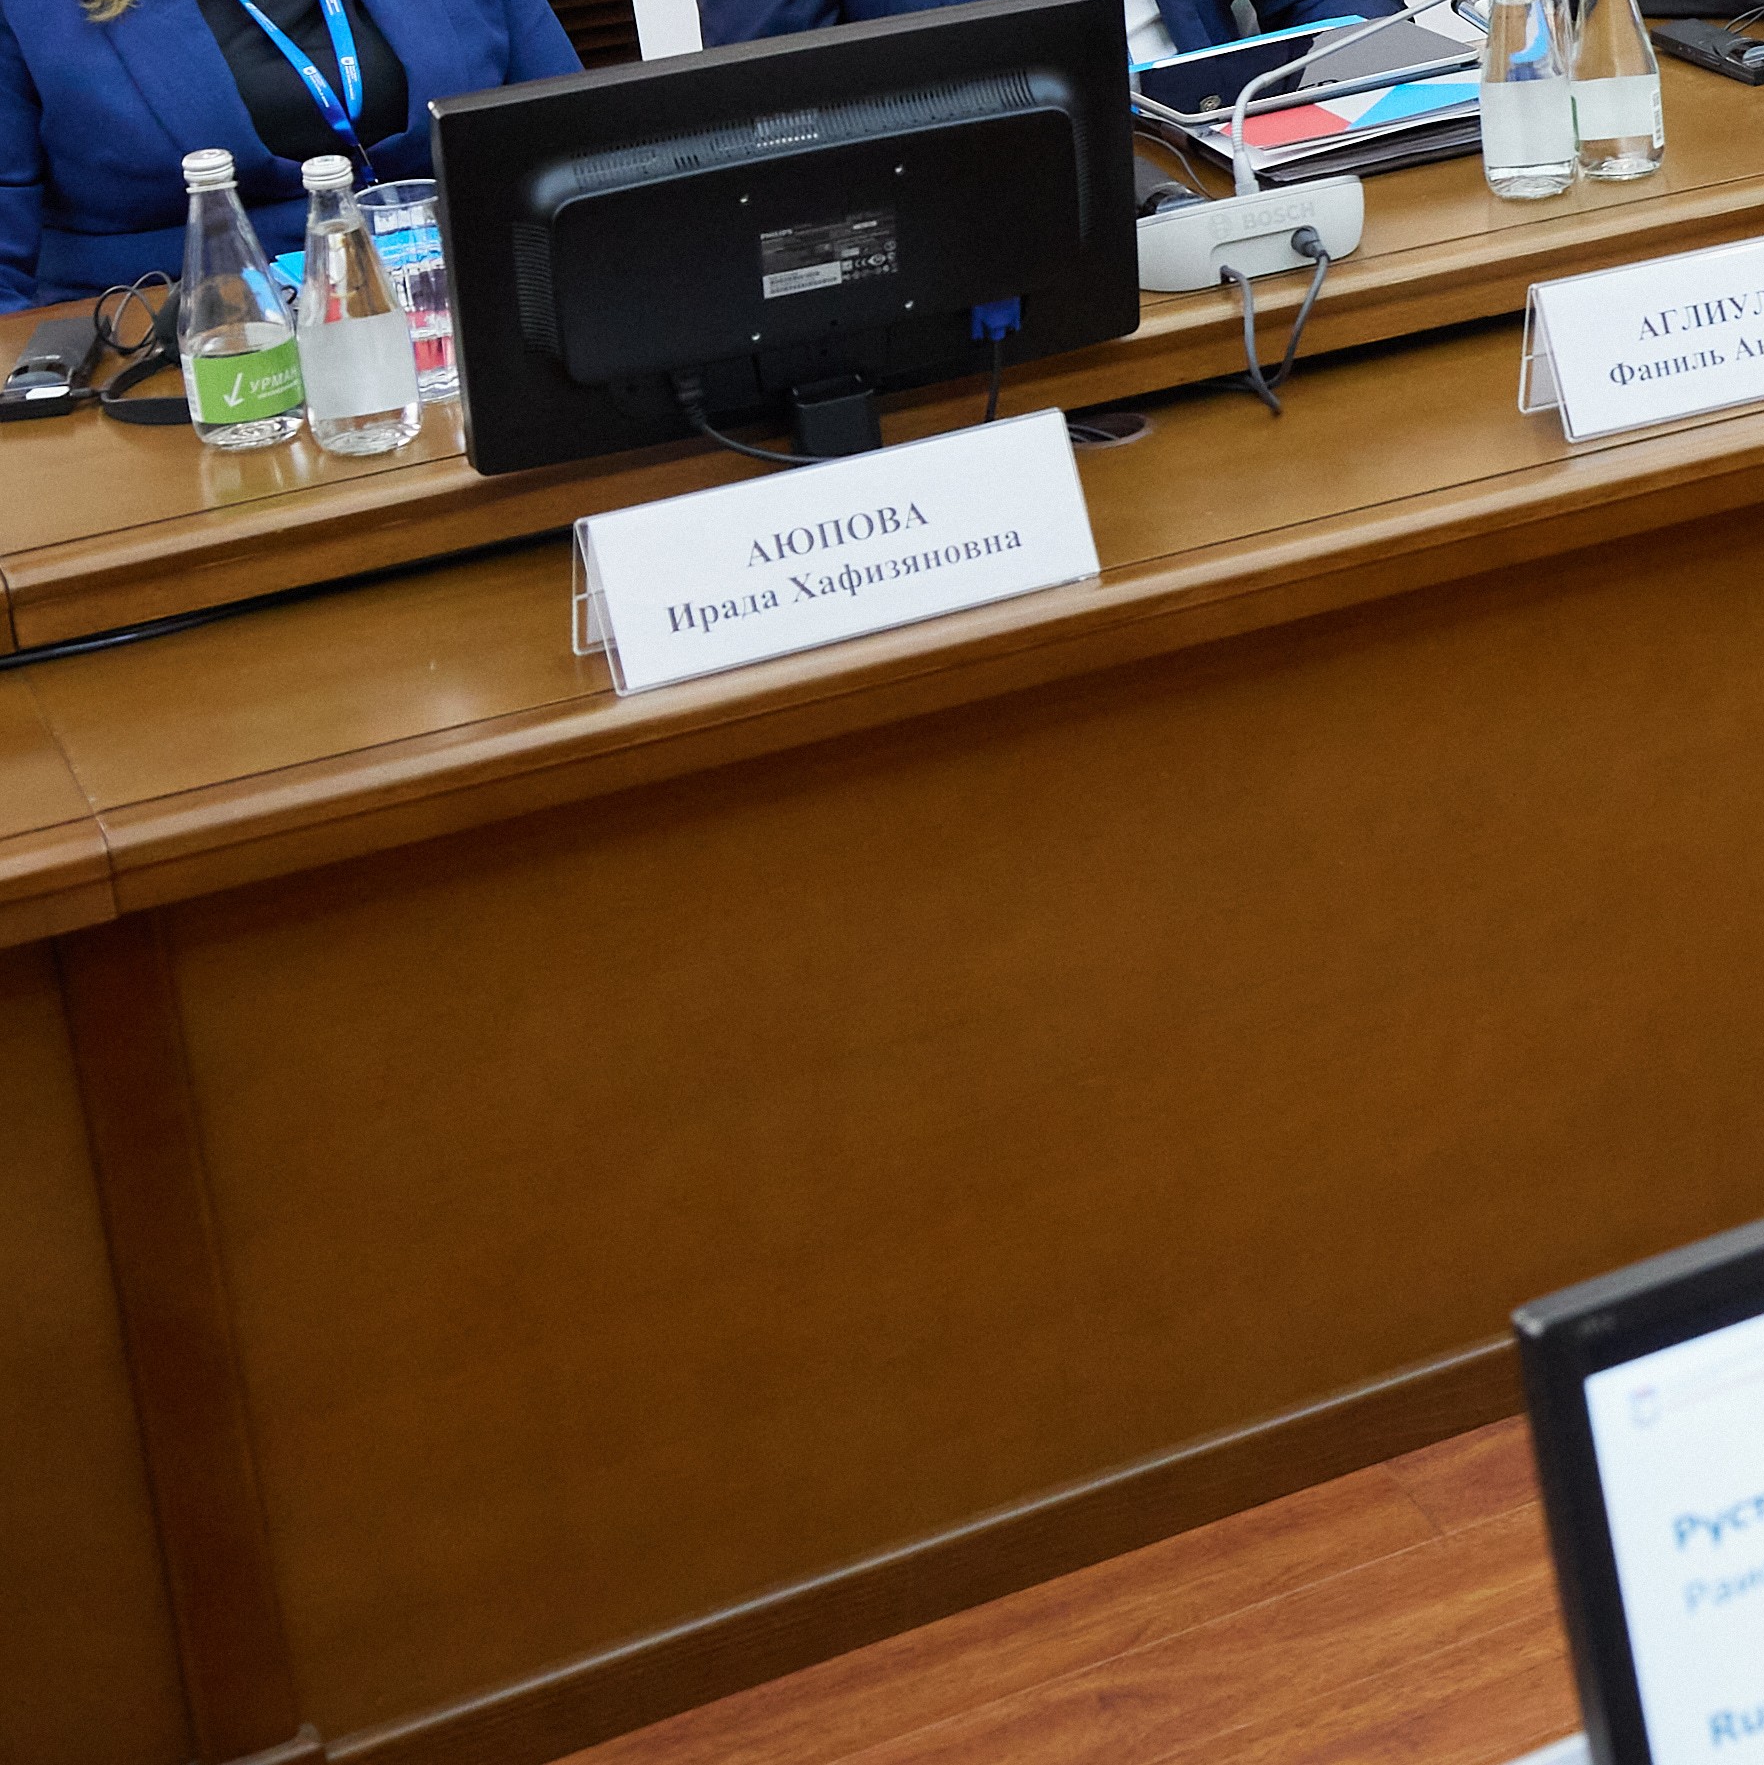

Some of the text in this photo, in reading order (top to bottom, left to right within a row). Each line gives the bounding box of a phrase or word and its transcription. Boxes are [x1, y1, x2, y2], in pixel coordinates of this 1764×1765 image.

[1608, 348, 1725, 386] Фаниль
[746, 502, 928, 567] АЮПОВА
[666, 529, 1022, 633] Ирада Хафизяновна
